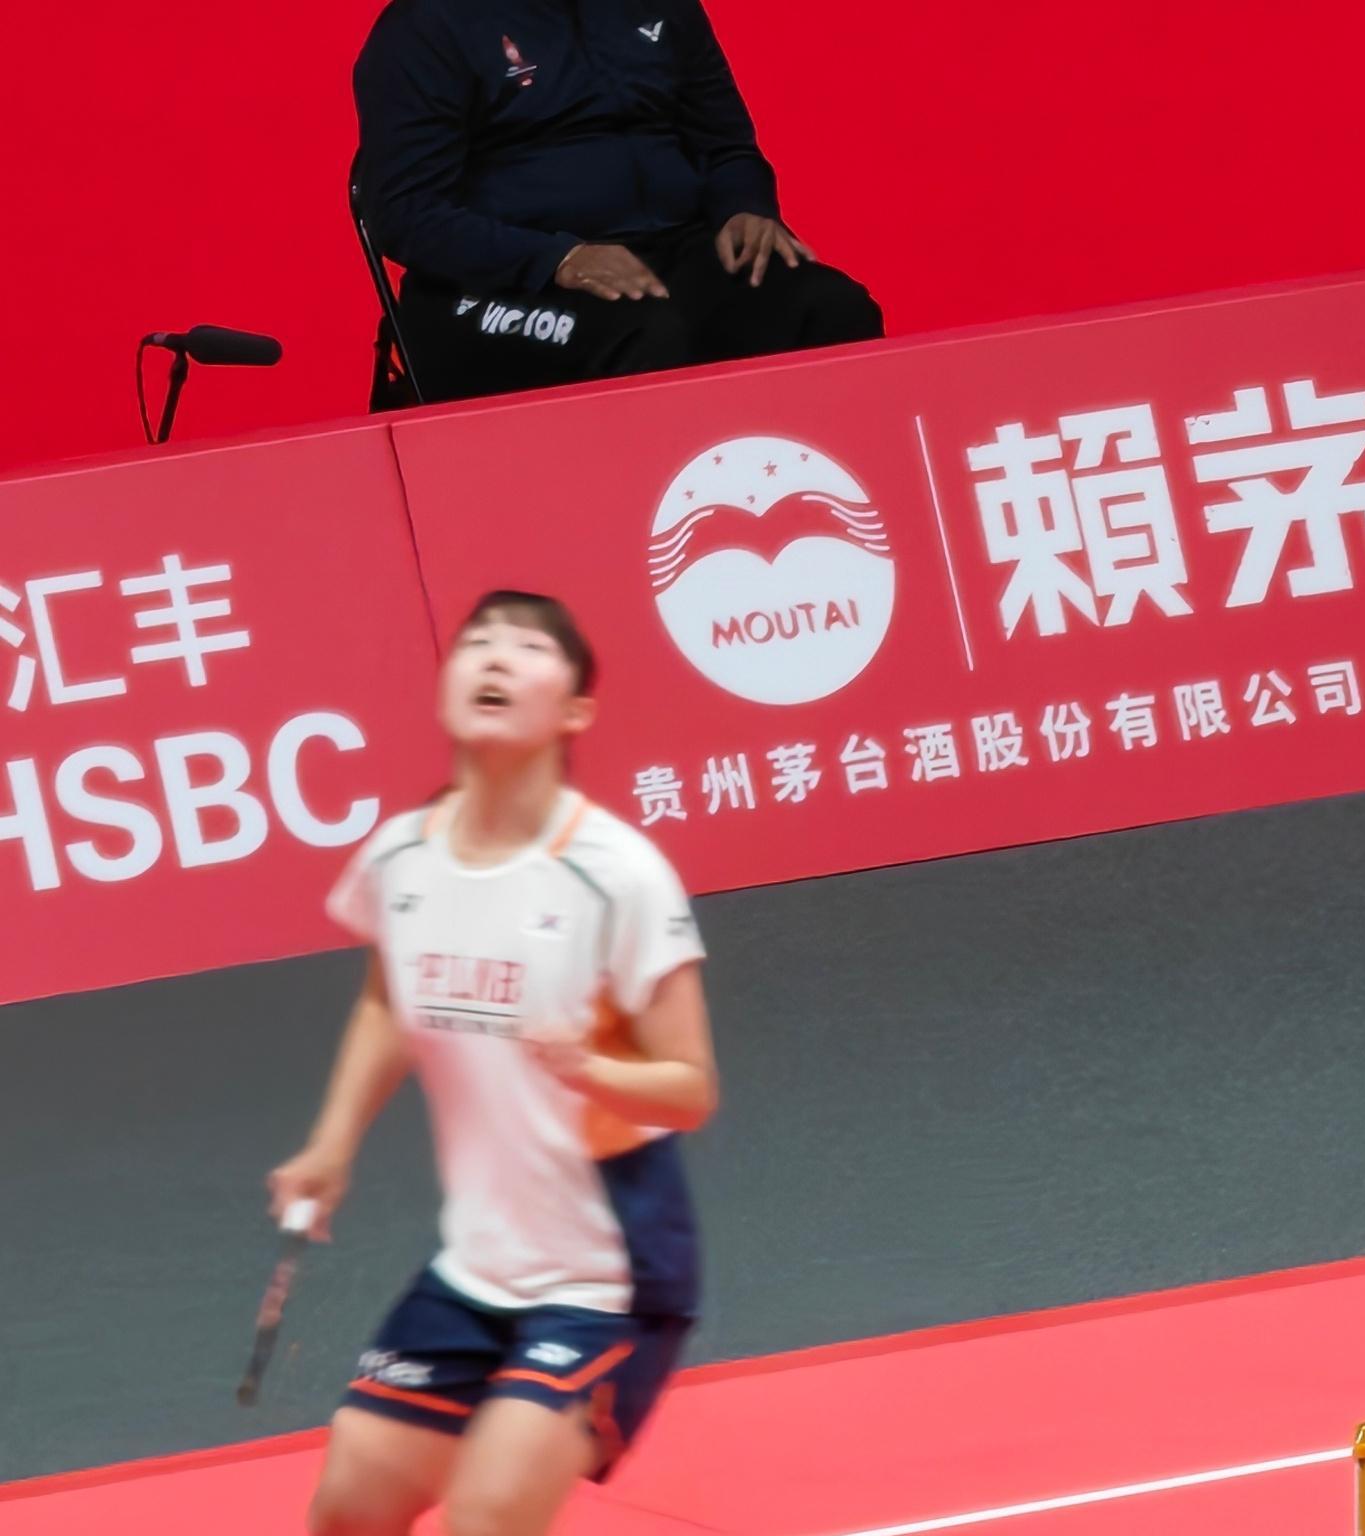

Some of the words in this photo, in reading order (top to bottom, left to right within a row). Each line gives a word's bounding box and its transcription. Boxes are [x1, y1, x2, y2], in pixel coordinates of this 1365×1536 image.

[0, 554, 251, 712] 汇丰
[712, 598, 860, 648] MOUTAI
[0, 712, 380, 891] HSBC
